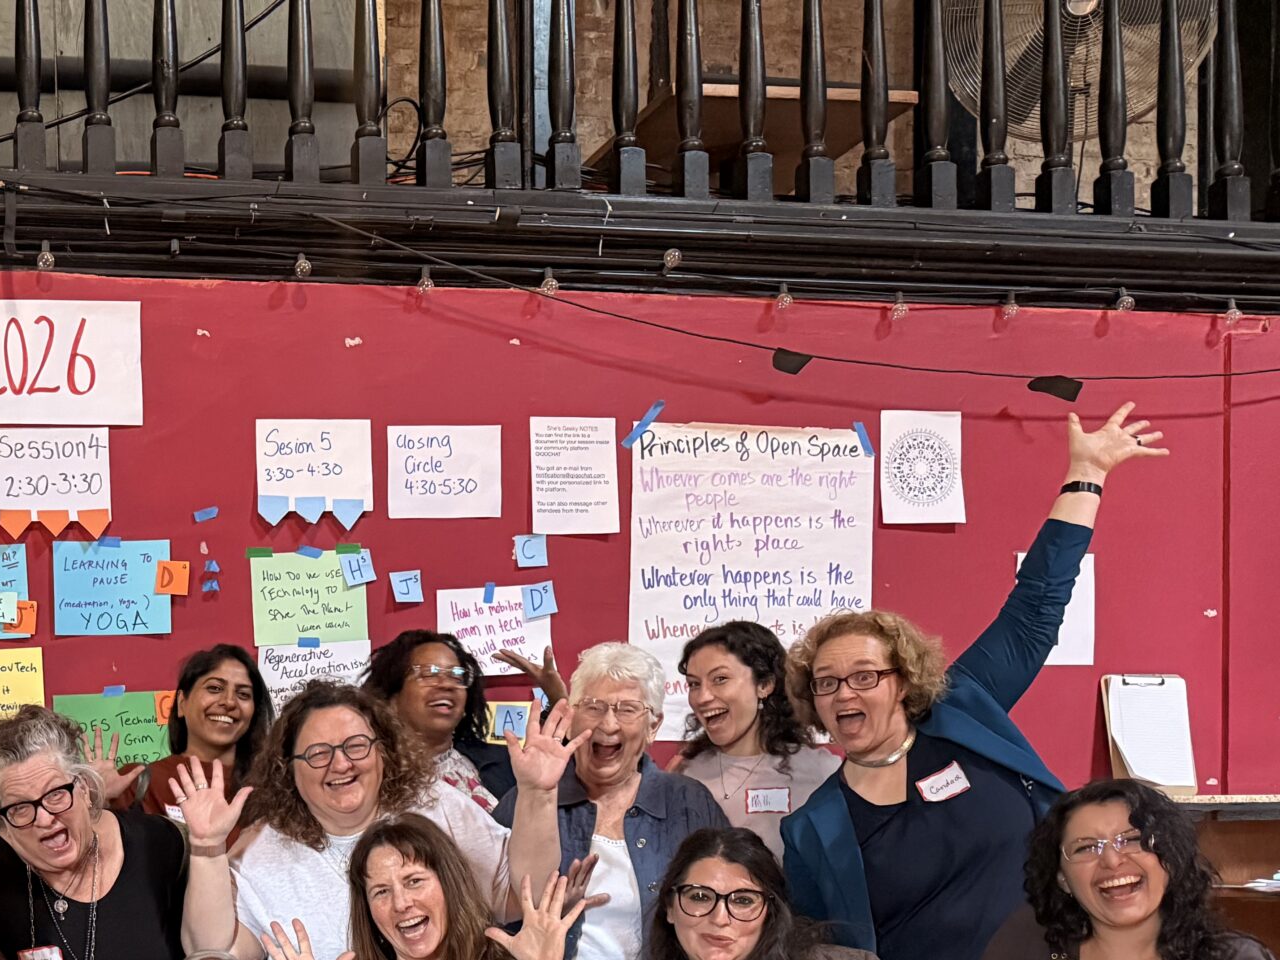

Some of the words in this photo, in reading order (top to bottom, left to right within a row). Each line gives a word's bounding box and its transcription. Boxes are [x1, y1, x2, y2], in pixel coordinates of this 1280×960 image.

[87, 433, 107, 460] 4
[264, 428, 316, 458] Sesion
[319, 431, 333, 451] 5
[396, 434, 453, 458] Closing
[639, 429, 730, 460] Principles
[733, 431, 751, 461] of
[756, 432, 803, 460] Open
[807, 434, 861, 466] Space
[264, 462, 344, 482] 3:30-4:30
[404, 455, 445, 475] Circle
[4, 472, 103, 497] 2:30-3:30
[404, 477, 478, 496] 4:30-5:30
[639, 467, 704, 492] Whoever
[711, 472, 756, 486] comes
[761, 473, 787, 487] are
[789, 469, 812, 487] the
[818, 470, 857, 500] right
[684, 490, 740, 511] people
[638, 515, 706, 540] Wherever
[729, 511, 802, 537] happens
[808, 513, 825, 529] is
[829, 509, 857, 529] the
[522, 539, 536, 560] C
[754, 537, 804, 559] place
[63, 556, 129, 572] LEARNING
[139, 553, 153, 564] TO
[348, 559, 363, 581] H
[93, 573, 129, 587] PAUSE
[160, 565, 174, 589] D
[398, 577, 413, 596] J
[641, 567, 715, 590] Whatever
[721, 563, 792, 594] happens
[800, 566, 817, 585] is
[827, 562, 855, 585] the
[450, 600, 471, 622] How
[474, 602, 484, 616] to
[530, 588, 544, 612] D
[683, 590, 720, 623] only
[721, 588, 759, 622] thing
[765, 587, 794, 608] that
[796, 588, 823, 608] could
[830, 589, 865, 609] have
[80, 610, 149, 632] YOGA
[485, 624, 496, 636] in
[498, 616, 523, 632] tech
[502, 635, 526, 649] more
[263, 648, 334, 672] Regenerative
[2, 685, 11, 695] it
[503, 710, 515, 731] A
[124, 733, 154, 746] Grim
